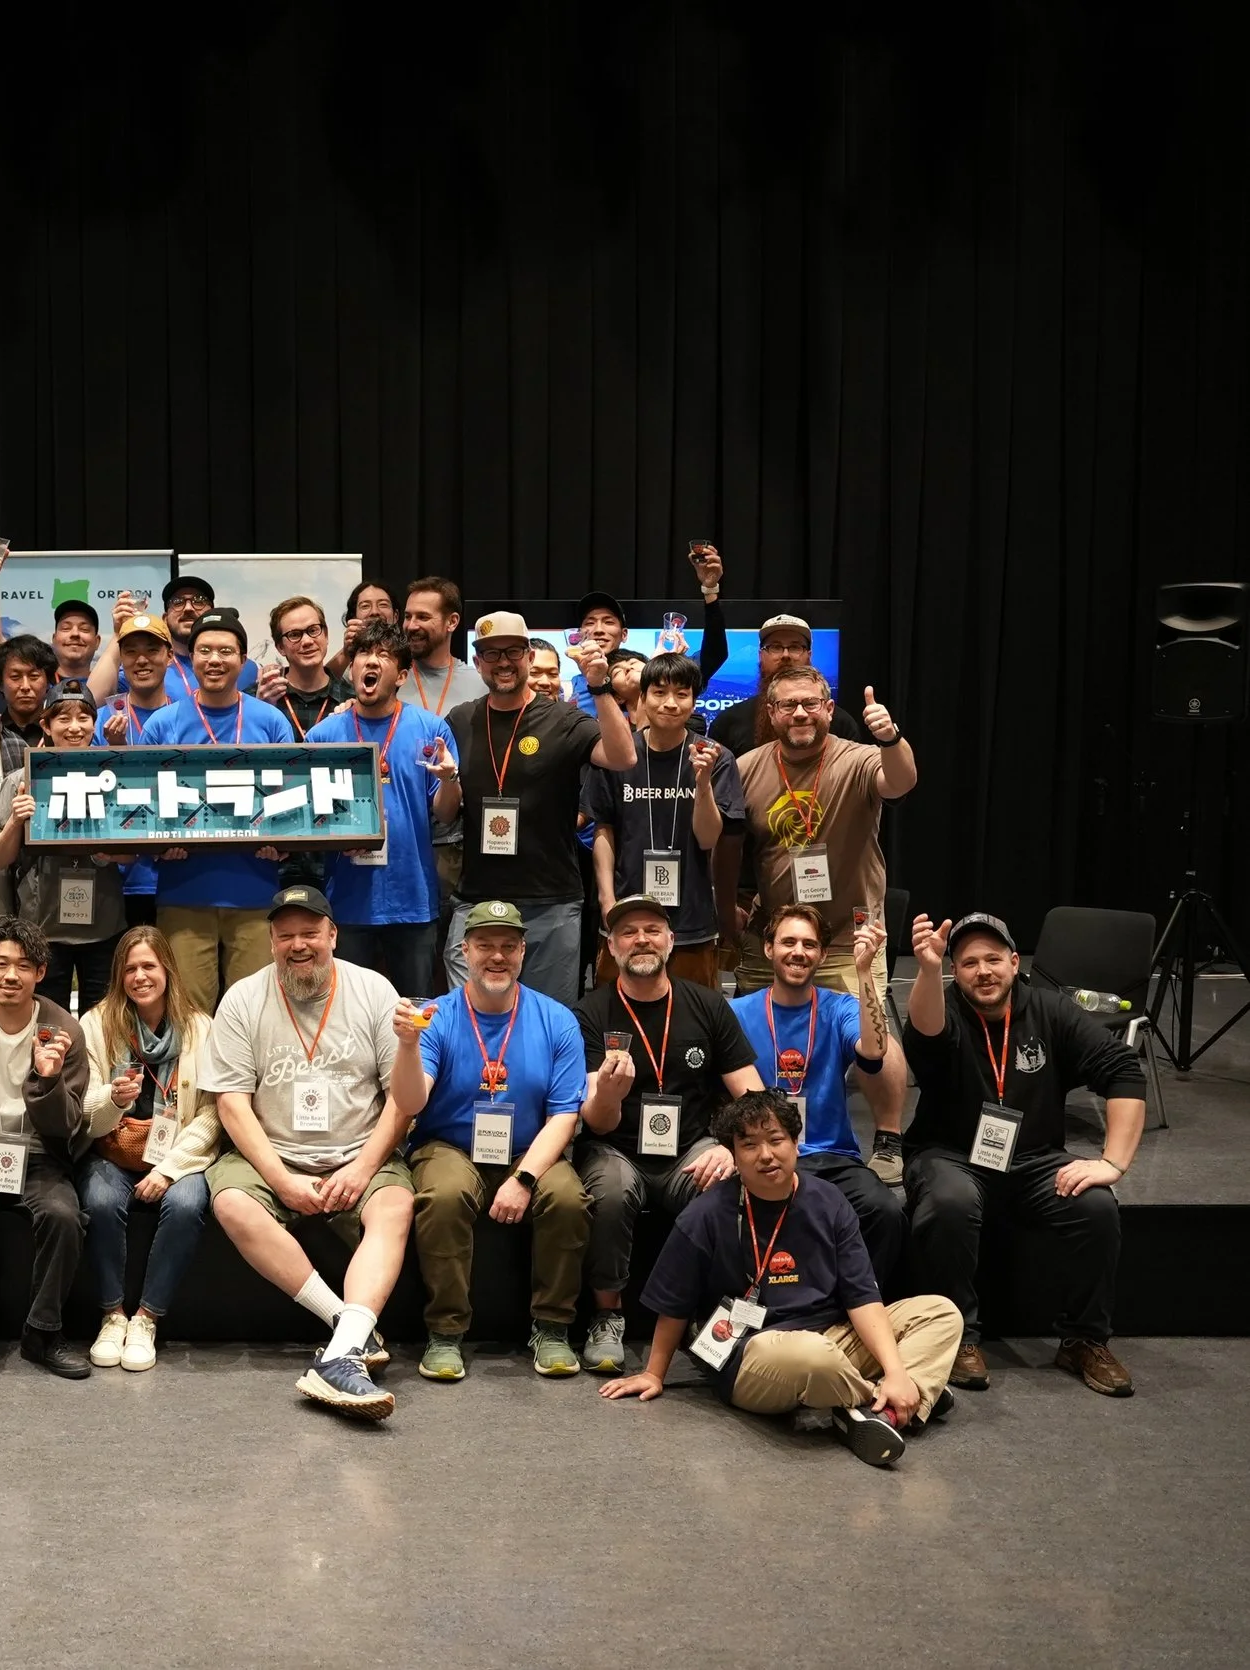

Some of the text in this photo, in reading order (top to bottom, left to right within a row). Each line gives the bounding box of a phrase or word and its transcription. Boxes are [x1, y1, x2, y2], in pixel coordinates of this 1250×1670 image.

[48, 767, 355, 819] ポートランド
[635, 788, 662, 799] BEER
[664, 787, 696, 799] BRAIN
[266, 1045, 305, 1058] LITTLE
[265, 1035, 357, 1086] Beast
[977, 1149, 1003, 1161] Little Hop
[978, 1155, 1001, 1167] Brewing
[768, 1275, 799, 1284] XLARGE
[697, 1340, 723, 1360] ORGANIZER
